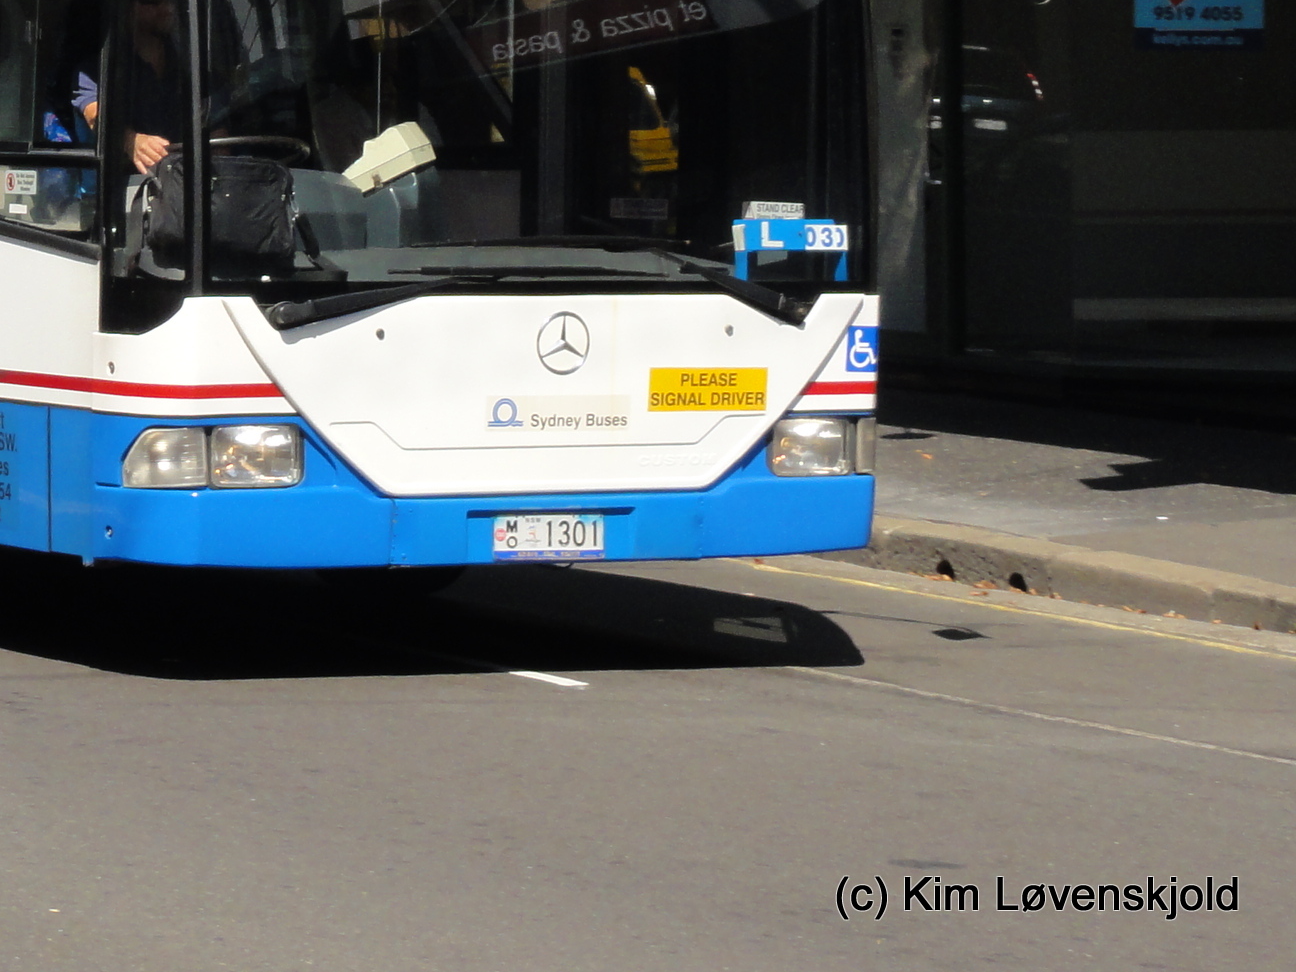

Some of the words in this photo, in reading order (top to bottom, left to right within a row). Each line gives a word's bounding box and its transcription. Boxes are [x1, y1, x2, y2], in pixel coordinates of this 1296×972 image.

[1154, 6, 1195, 20] 9519
[1200, 6, 1243, 21] 4055
[757, 203, 780, 213] STAND
[761, 221, 784, 247] L
[680, 373, 738, 387] PLEASE
[650, 392, 706, 406] SIGNAL
[710, 392, 765, 406] DRIVER
[531, 413, 582, 430] Sydney
[586, 413, 628, 427] Buses
[546, 520, 597, 547] 1301
